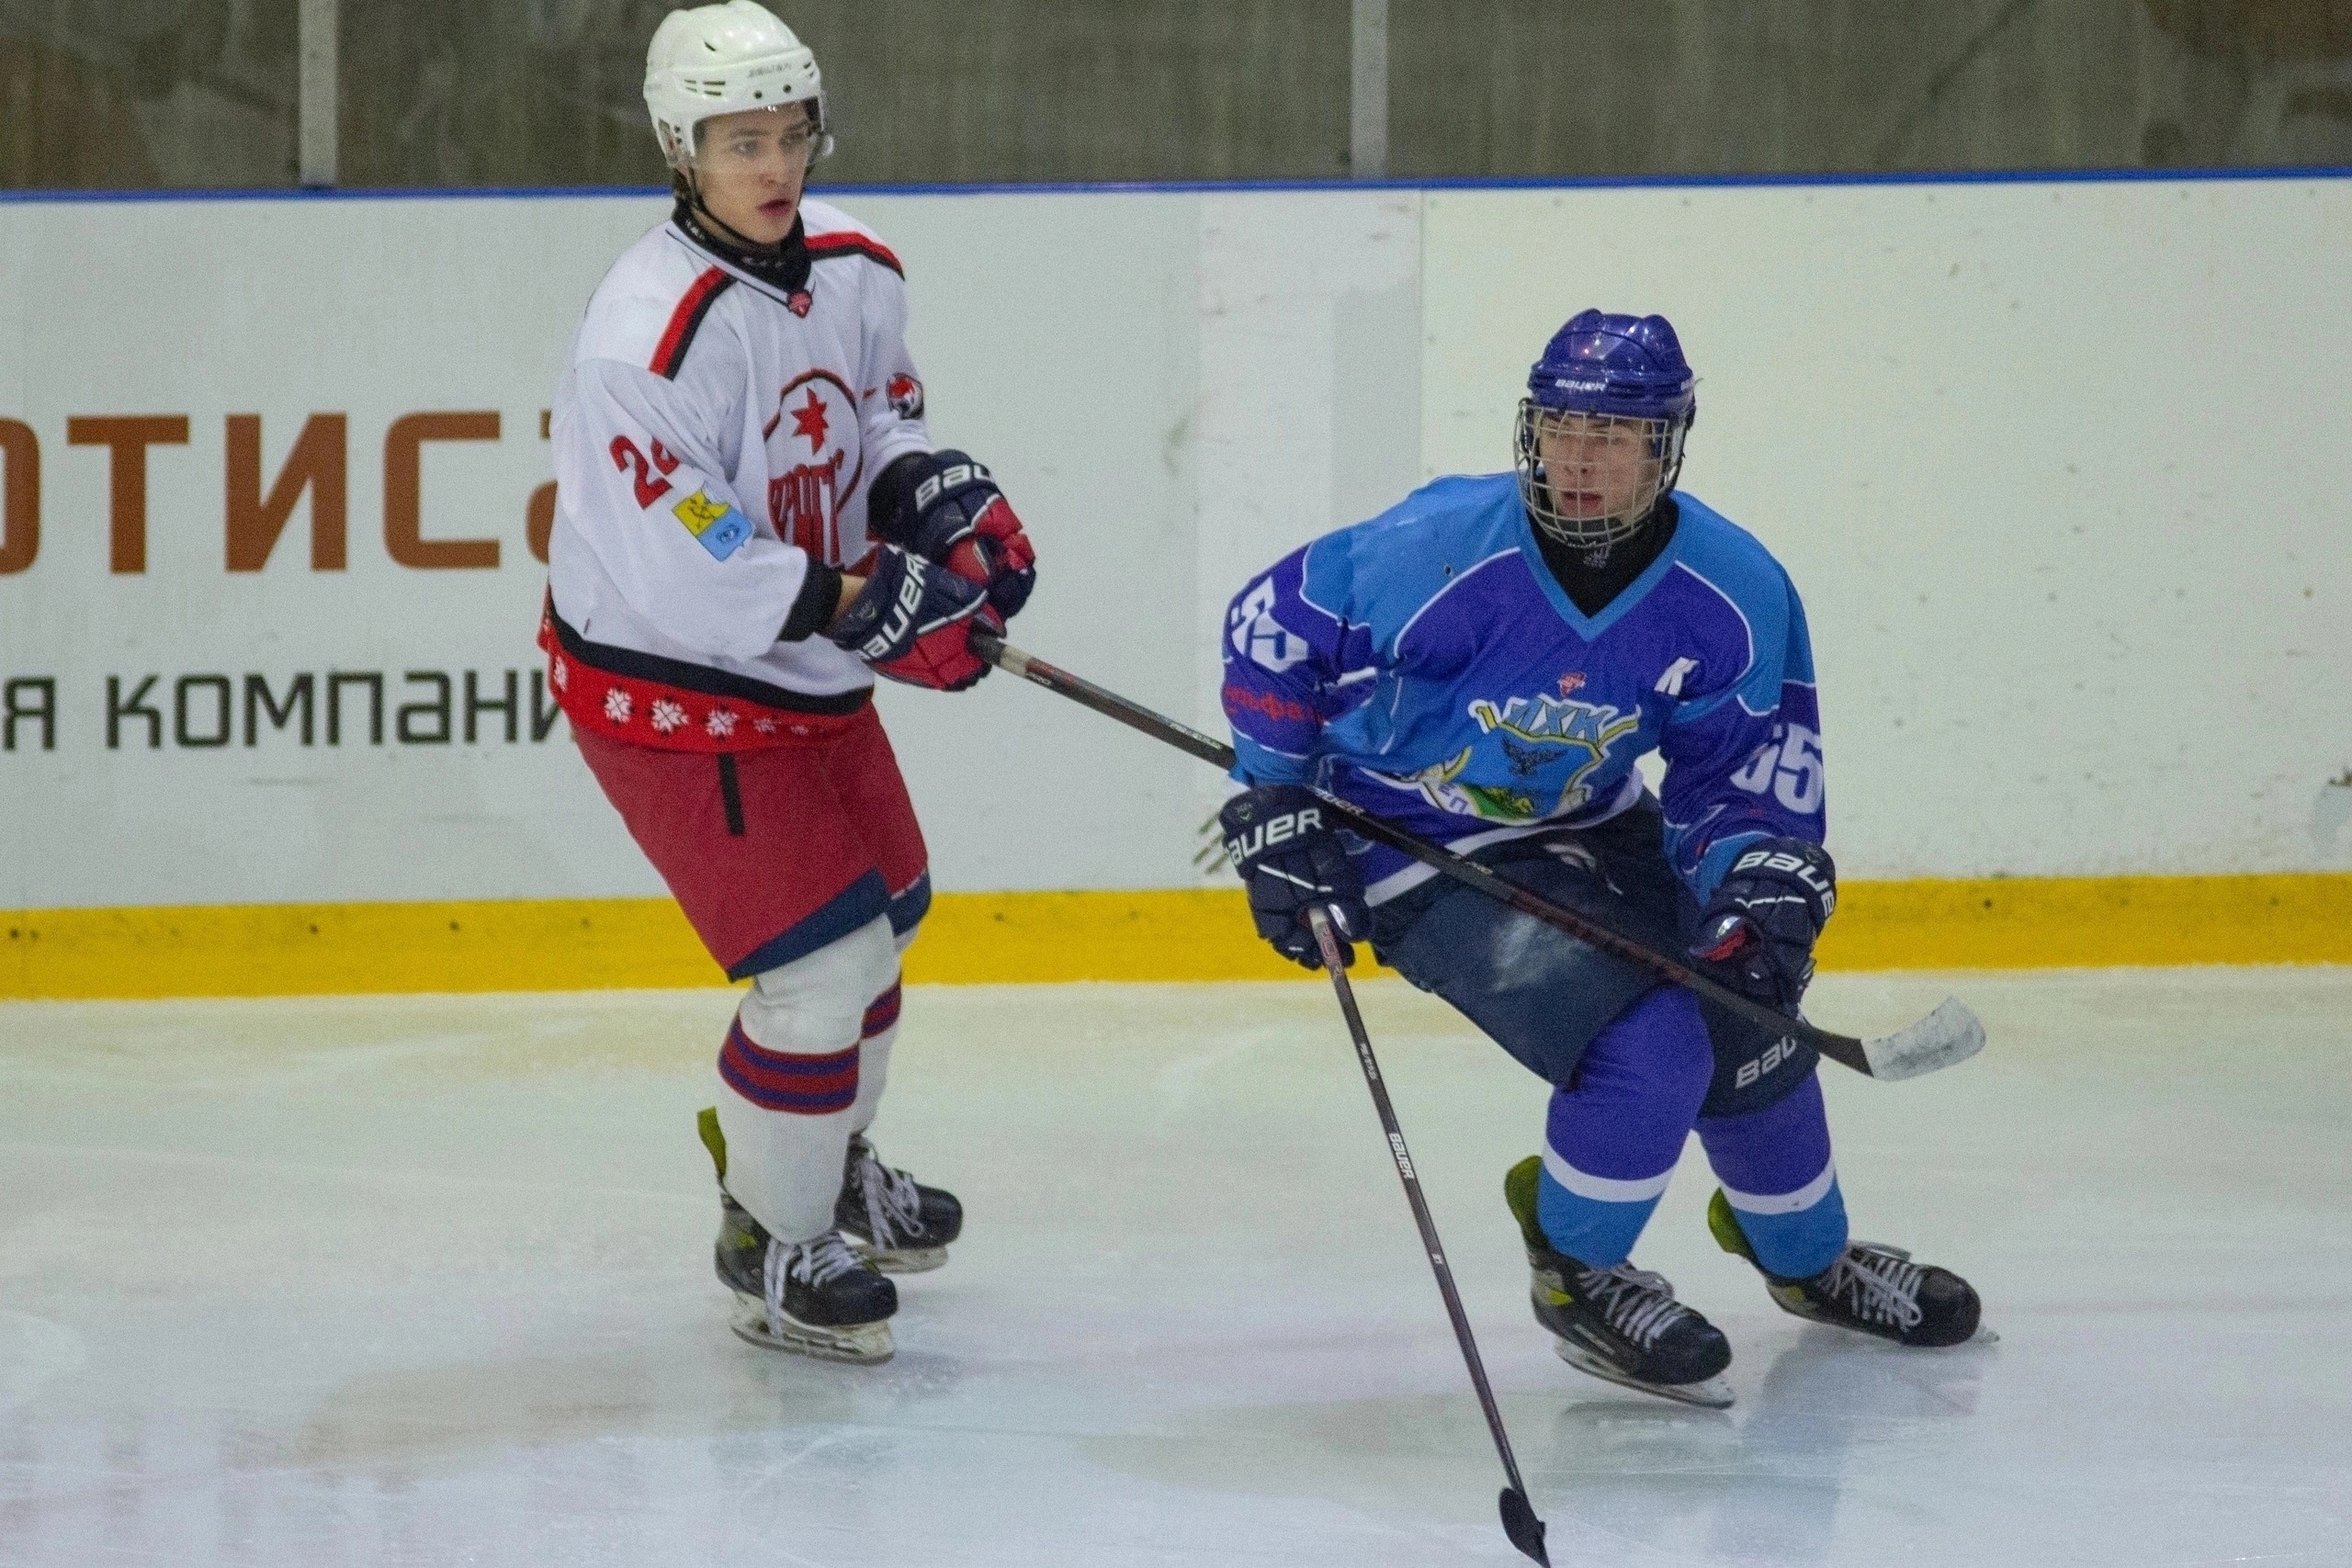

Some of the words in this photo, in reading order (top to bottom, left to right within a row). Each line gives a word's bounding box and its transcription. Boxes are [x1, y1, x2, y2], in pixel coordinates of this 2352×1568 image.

[915, 464, 993, 512] BAU
[858, 552, 930, 660] AUER
[106, 668, 562, 748] компани
[1228, 808, 1323, 866] AUER
[1733, 852, 1834, 918] BAUE
[1735, 1035, 1797, 1089] BAU
[1388, 1132, 1414, 1179] BAUER
